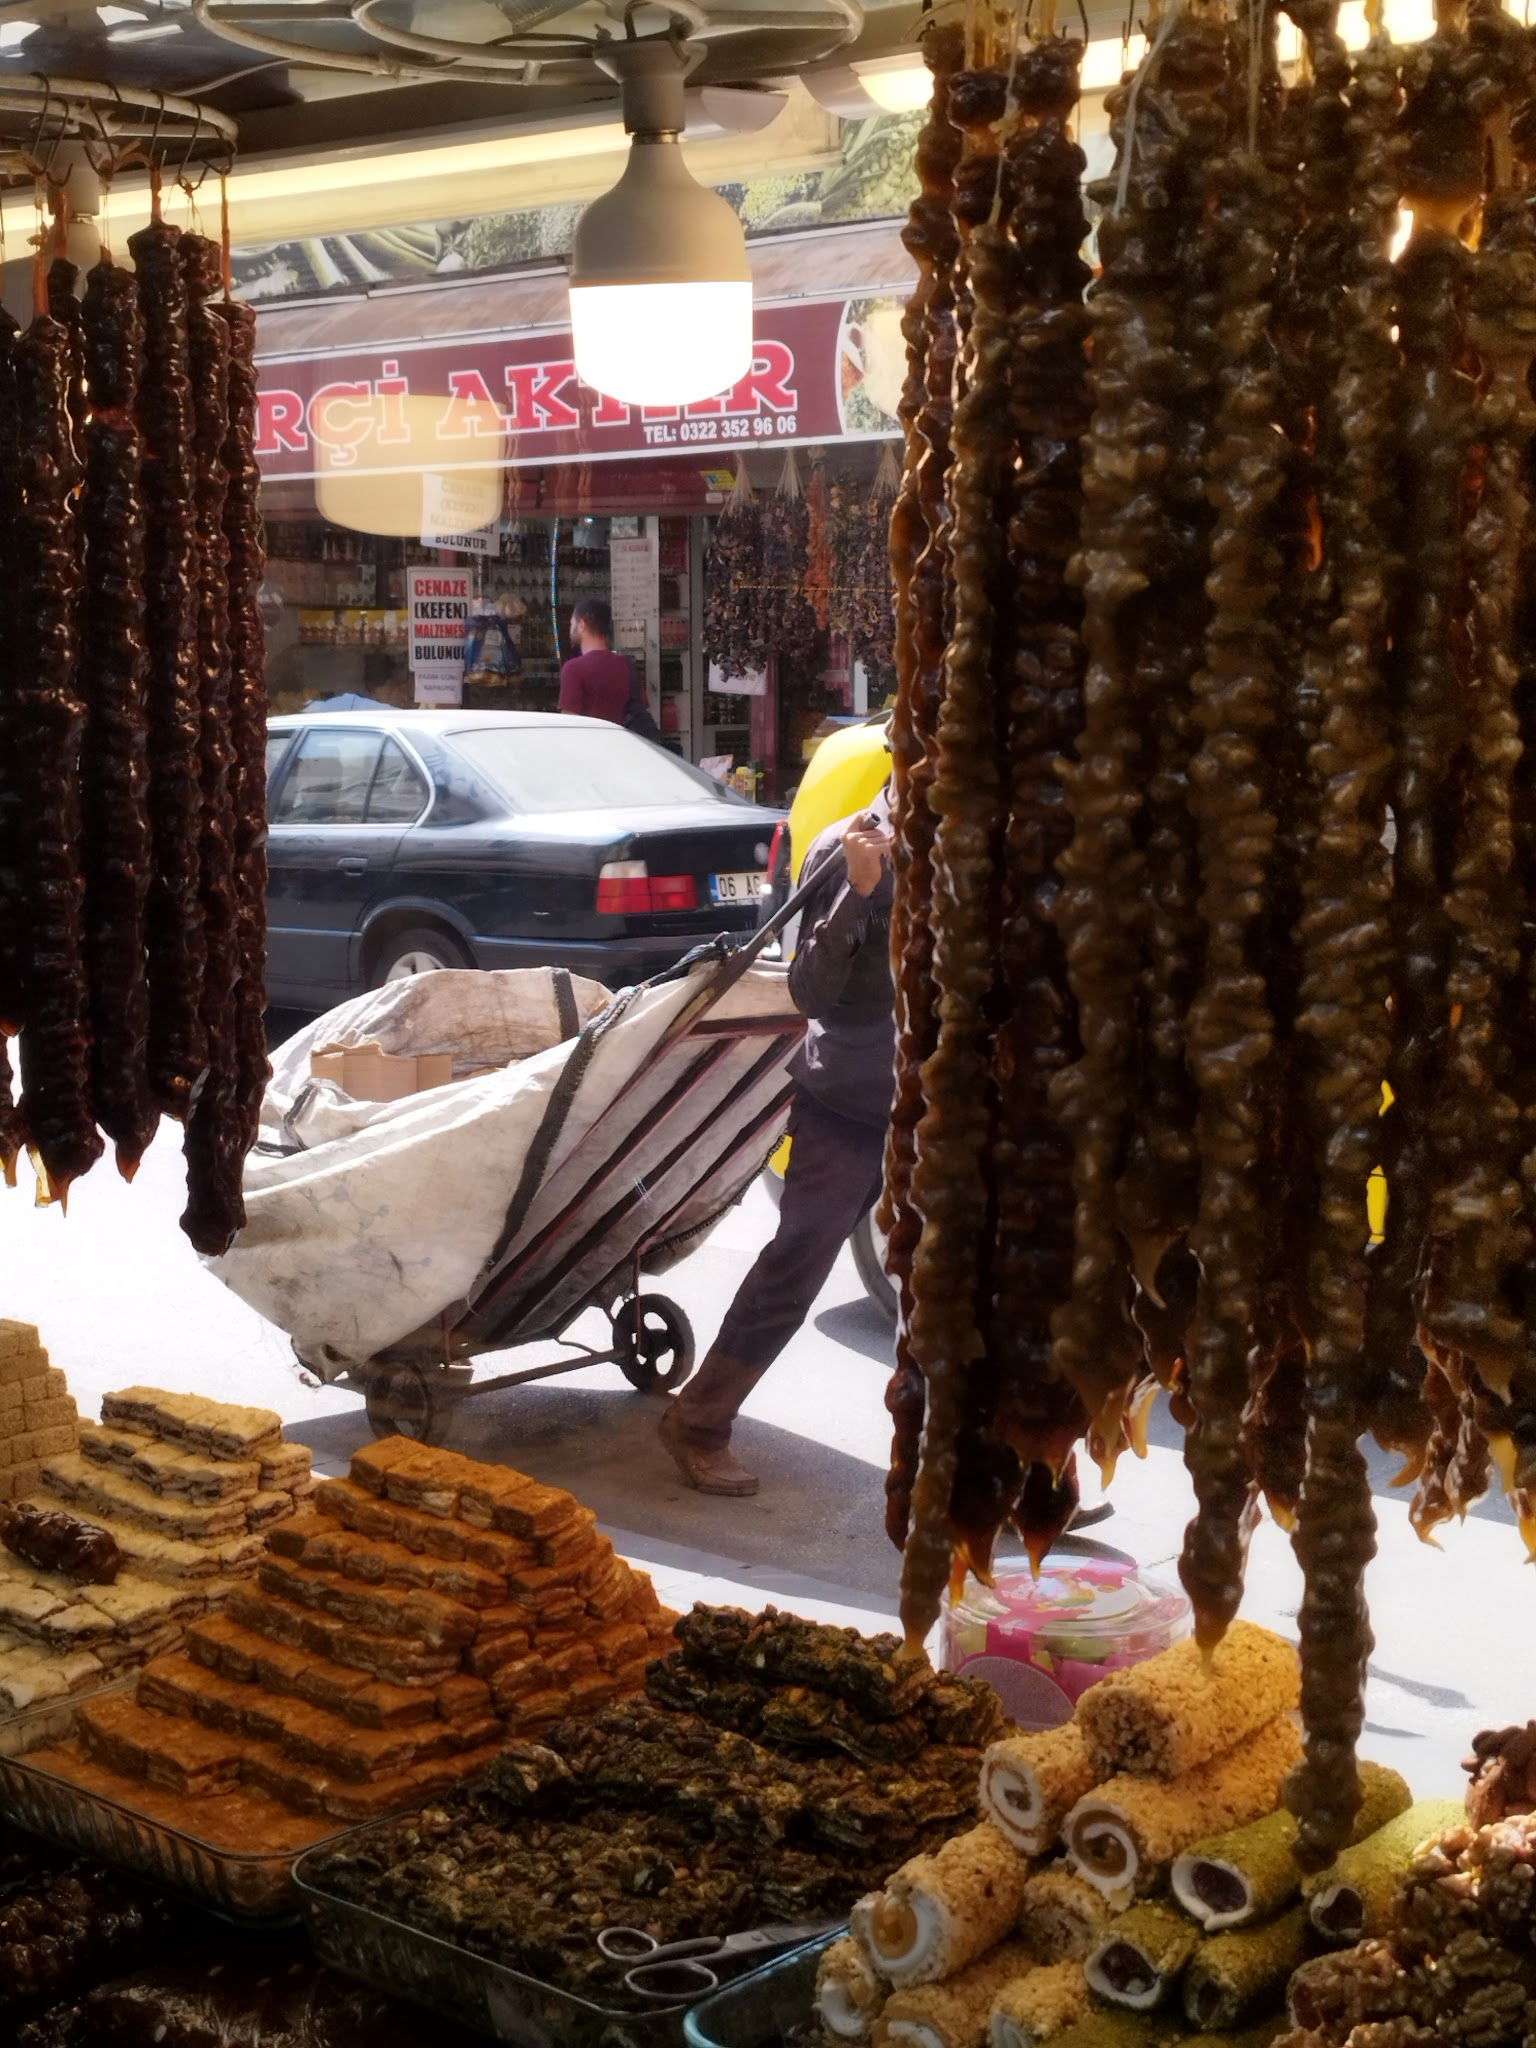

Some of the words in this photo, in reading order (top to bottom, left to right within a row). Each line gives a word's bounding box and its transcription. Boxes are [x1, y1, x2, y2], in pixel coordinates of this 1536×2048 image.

[437, 340, 798, 440] AKR
[643, 425, 677, 444] TEL:
[680, 421, 717, 442] 0322
[721, 418, 749, 439] 352
[753, 417, 773, 437] 96
[777, 415, 797, 434] 06
[435, 535, 488, 550] BULUNUR
[414, 578, 468, 597] CENAZE
[414, 601, 468, 619] (KEFEN)
[414, 623, 466, 639] MALZEMES
[719, 876, 736, 897] 06
